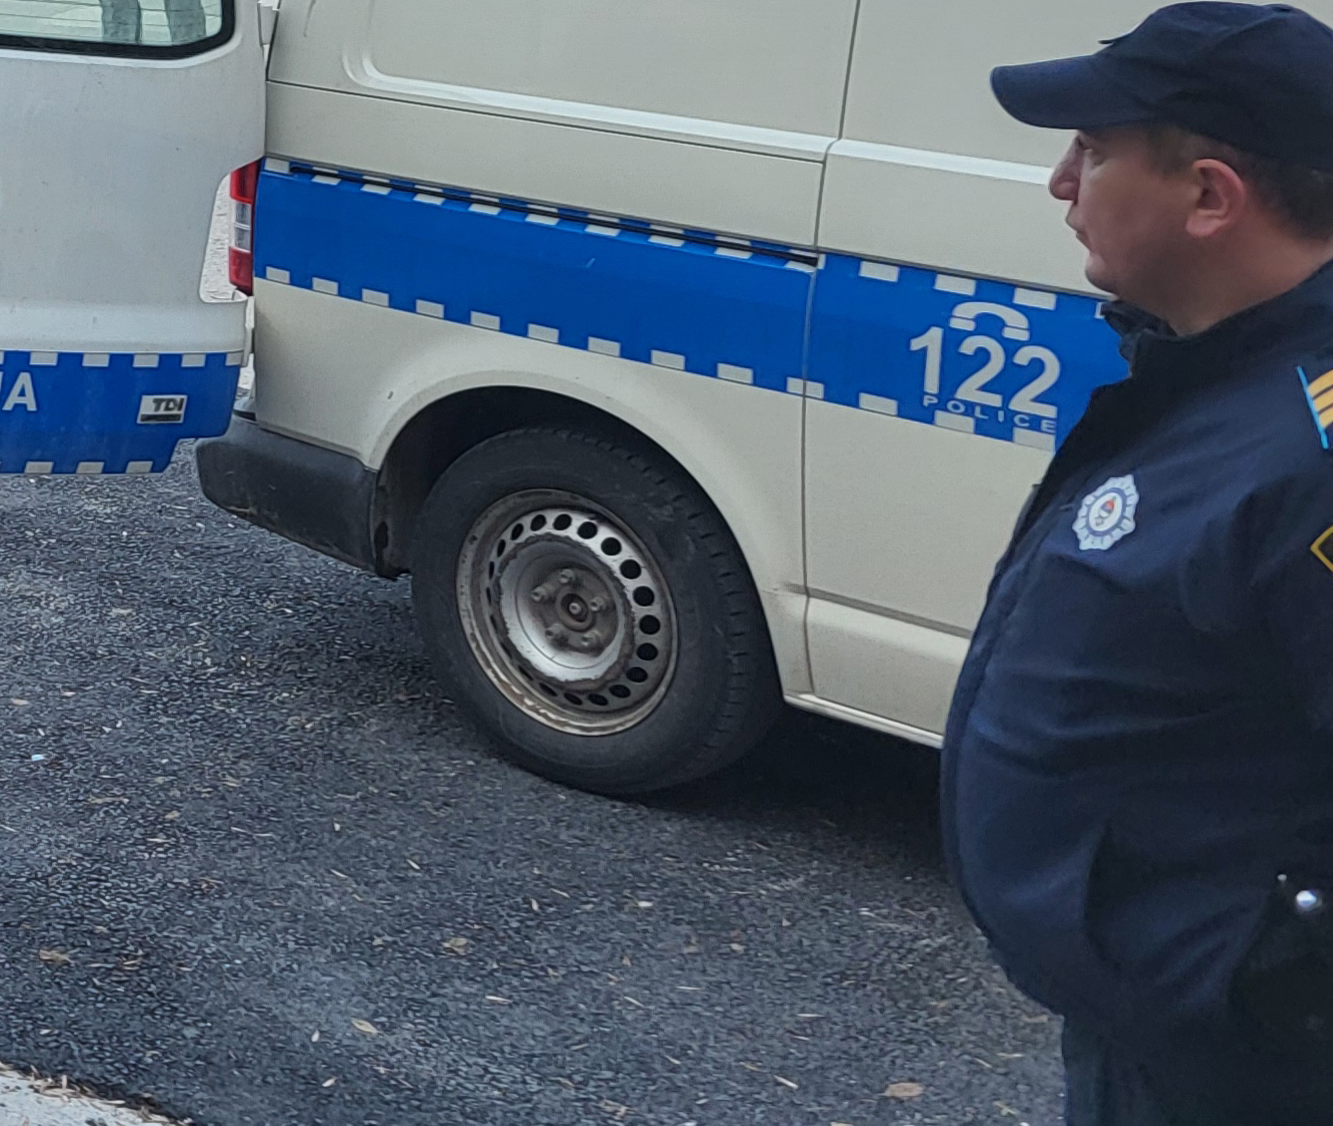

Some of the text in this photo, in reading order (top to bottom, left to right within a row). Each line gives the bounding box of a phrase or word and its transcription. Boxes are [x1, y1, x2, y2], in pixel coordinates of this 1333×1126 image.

[909, 326, 1061, 418] 122
[152, 397, 185, 412] TDI
[922, 394, 1057, 434] POLICE
